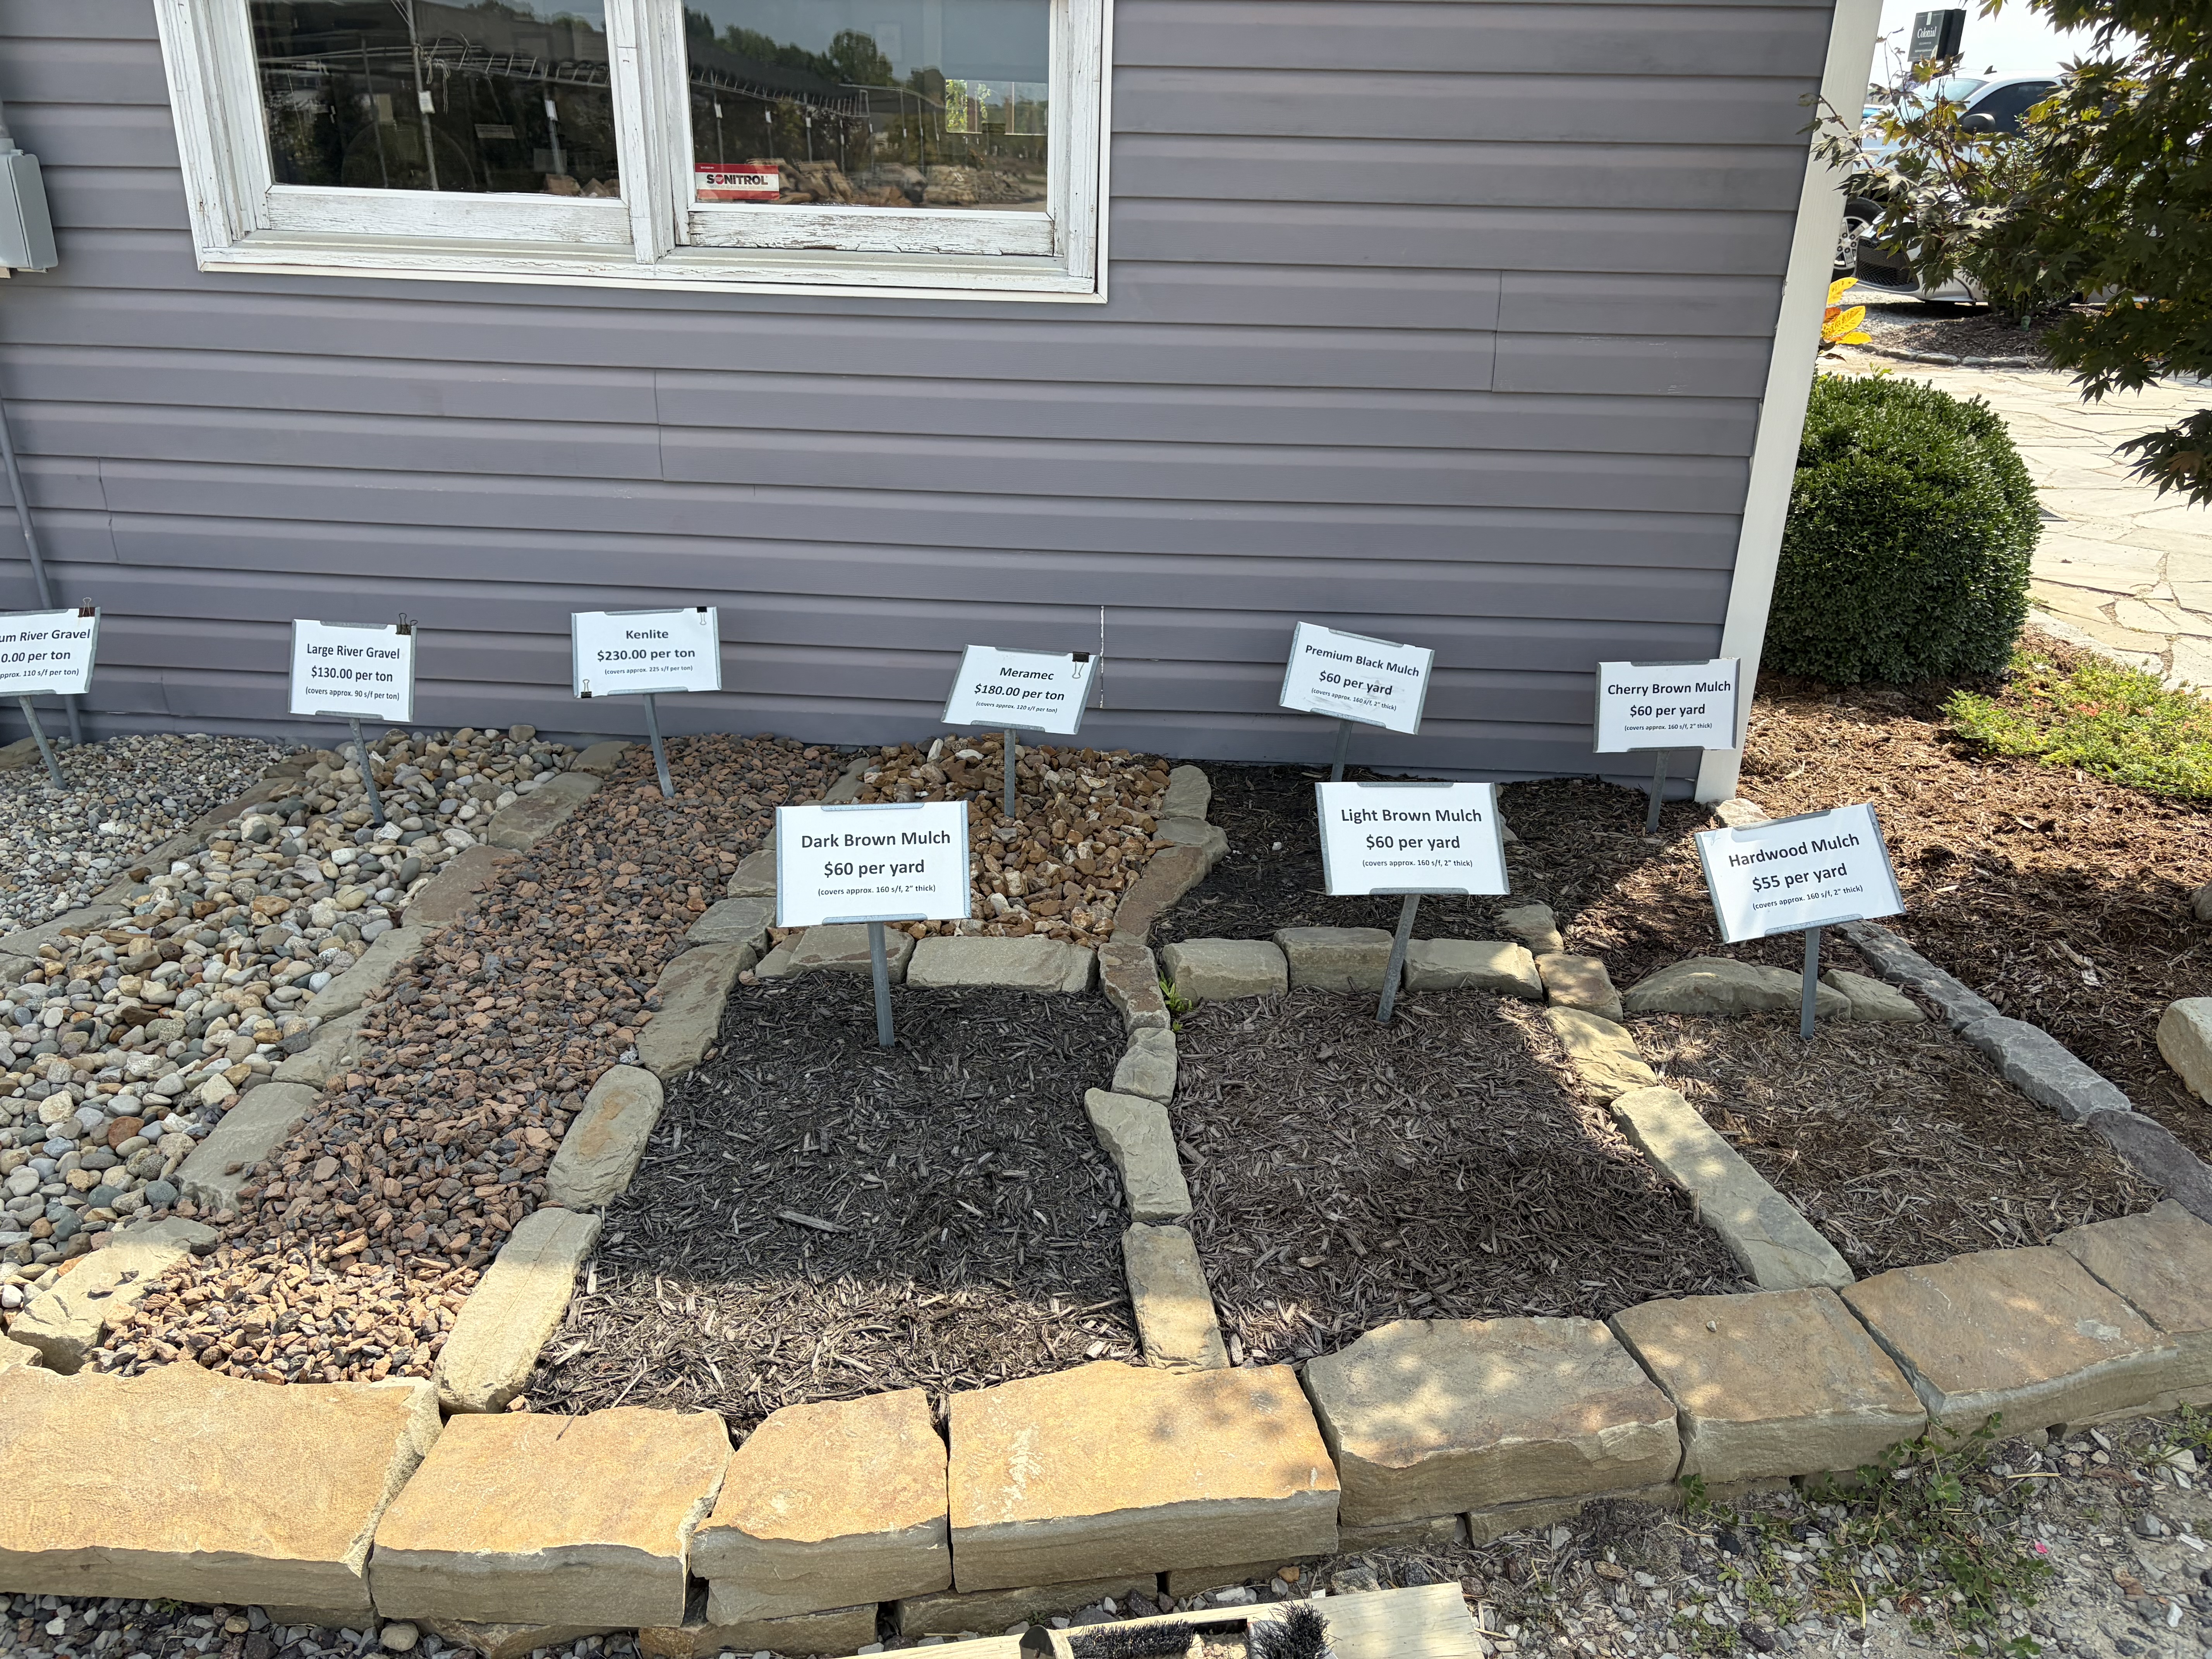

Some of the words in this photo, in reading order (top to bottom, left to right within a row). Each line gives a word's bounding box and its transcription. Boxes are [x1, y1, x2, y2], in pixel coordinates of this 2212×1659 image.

[1917, 26, 1937, 38] Colonial
[706, 174, 768, 185] SONITROL
[19, 631, 49, 642] River
[51, 629, 91, 639] Gravel
[626, 629, 669, 639] Kenlite
[27, 653, 48, 663] per
[50, 651, 71, 660] ton
[307, 643, 334, 657] Large
[337, 645, 364, 657] River
[366, 647, 400, 659] Gravel
[597, 649, 647, 663] $230.00
[651, 651, 672, 661] per
[674, 649, 695, 658] ton
[1305, 644, 1353, 663] Premium
[1355, 655, 1384, 669] Black
[1386, 662, 1419, 677] Mulch
[37, 669, 48, 677] s/f
[64, 668, 79, 676] ton)
[311, 665, 352, 679] $130.00
[355, 672, 373, 682] per
[375, 671, 393, 682] ton
[999, 667, 1054, 680] Meramec
[1319, 670, 1341, 684] $60
[1343, 678, 1364, 688] per
[1366, 683, 1393, 696] yard
[1607, 684, 1649, 697] Cherry
[1652, 684, 1691, 694] Brown
[1695, 680, 1731, 693] Mulch
[306, 686, 328, 695] (covers
[364, 690, 373, 699] s/f
[386, 692, 400, 701] ton)
[974, 683, 1020, 696] $180.00
[1022, 690, 1043, 699] per
[1045, 691, 1065, 701] ton
[1311, 687, 1331, 696] (covers
[1331, 693, 1352, 701] approx.
[1363, 698, 1372, 706] s/f,
[1381, 703, 1396, 712] thick)
[1630, 704, 1652, 718] $60
[1656, 707, 1676, 718] per
[1679, 703, 1705, 718] yard
[1341, 808, 1378, 824] Light
[1382, 809, 1431, 821] Brown
[1435, 809, 1482, 822] Mulch
[802, 833, 839, 848] Dark
[844, 834, 896, 847] Brown
[902, 830, 950, 845] Mulch
[1366, 834, 1394, 850] $60
[1398, 838, 1423, 851] per
[1427, 835, 1460, 851] yard
[1728, 842, 1808, 867] Hardwood
[1811, 833, 1860, 853] Mulch
[824, 861, 854, 878] $60
[859, 864, 885, 878] per
[890, 859, 924, 877] yard
[1362, 859, 1388, 868] (covers
[1431, 859, 1443, 867] s/f,
[1453, 860, 1473, 868] thick)
[1752, 875, 1780, 893] $55
[1784, 872, 1809, 889] per
[1813, 862, 1848, 883] yard
[818, 888, 844, 897] (covers
[891, 885, 903, 893] s/f,
[915, 884, 936, 893] thick)
[1753, 901, 1778, 911] (covers
[1779, 896, 1805, 906] approx.
[1820, 890, 1832, 898] s/f,
[1843, 884, 1863, 894] thick)
